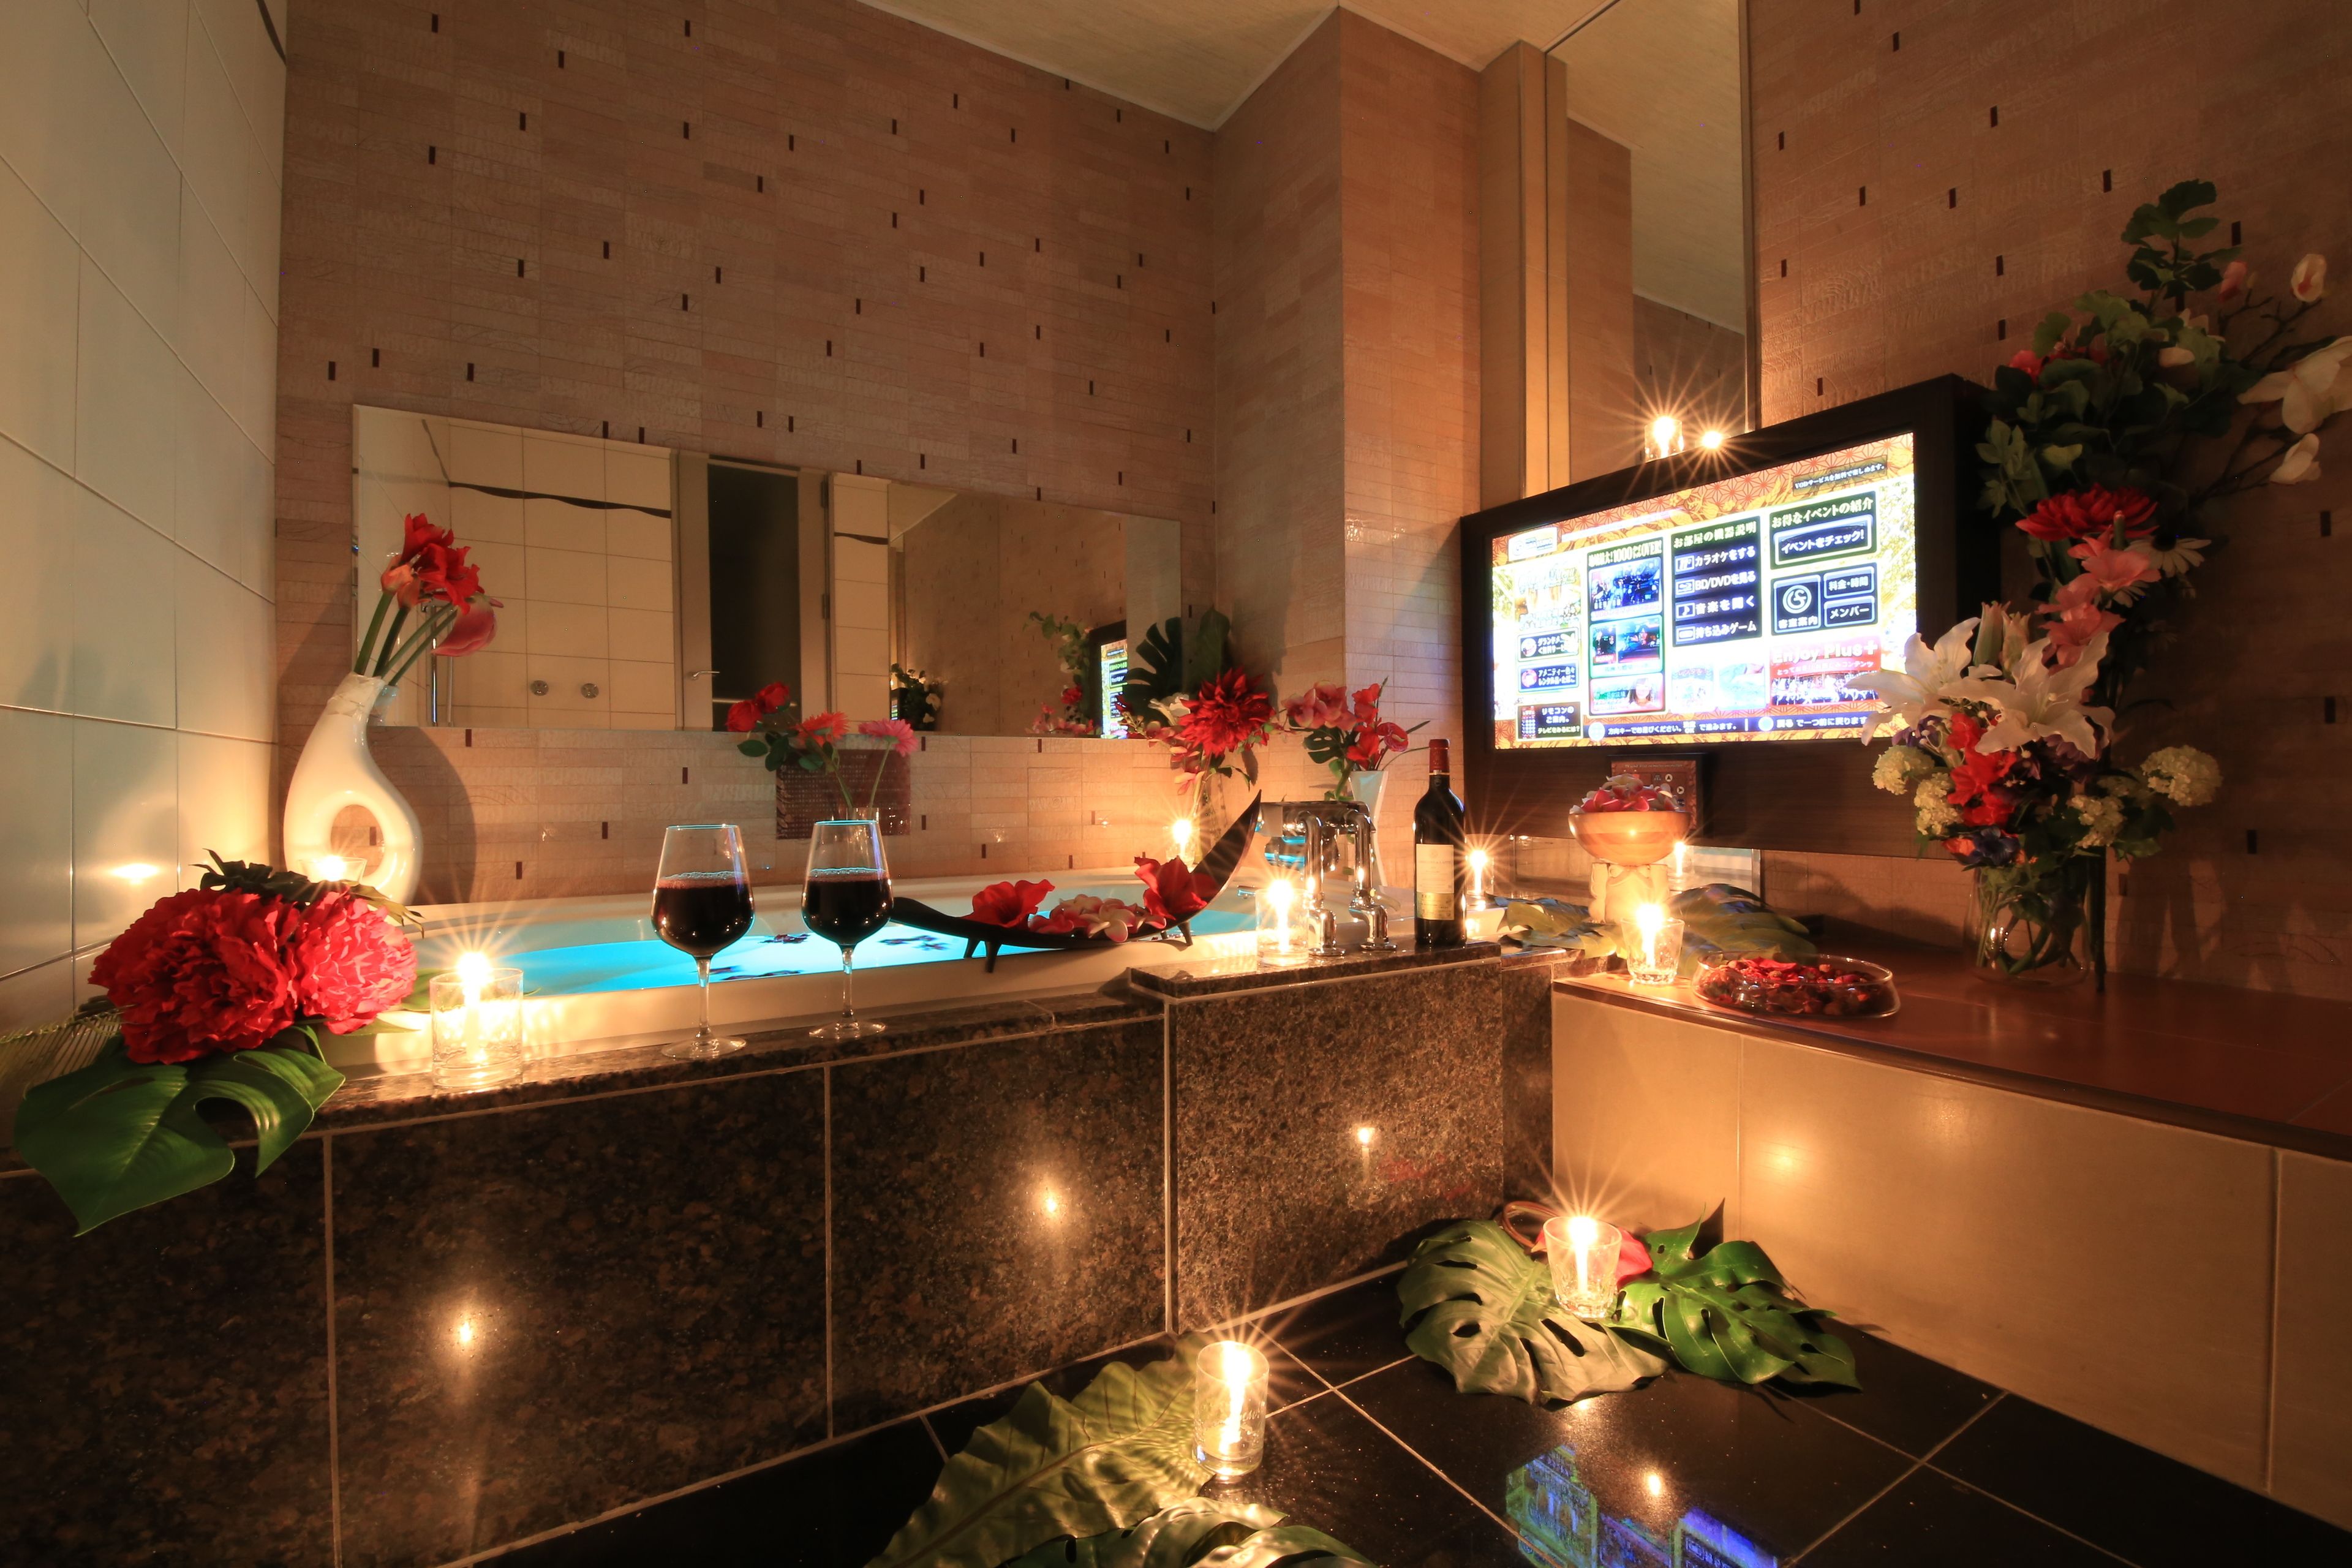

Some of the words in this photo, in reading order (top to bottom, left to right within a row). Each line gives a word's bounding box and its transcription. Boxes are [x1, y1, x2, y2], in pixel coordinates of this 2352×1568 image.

[1771, 497, 1874, 529] お得なイベントの紹介
[1673, 521, 1757, 548] お部屋の機器説明
[1695, 546, 1755, 567] カラオケをする
[1695, 571, 1756, 590] BD/DVDを見る
[1830, 606, 1869, 619] メンバー
[1695, 620, 1757, 639] 持ち込みゲーム
[1778, 616, 1818, 629] 客室案内
[1773, 647, 1820, 664] Enjoy
[1542, 706, 1574, 715] リモコンの
